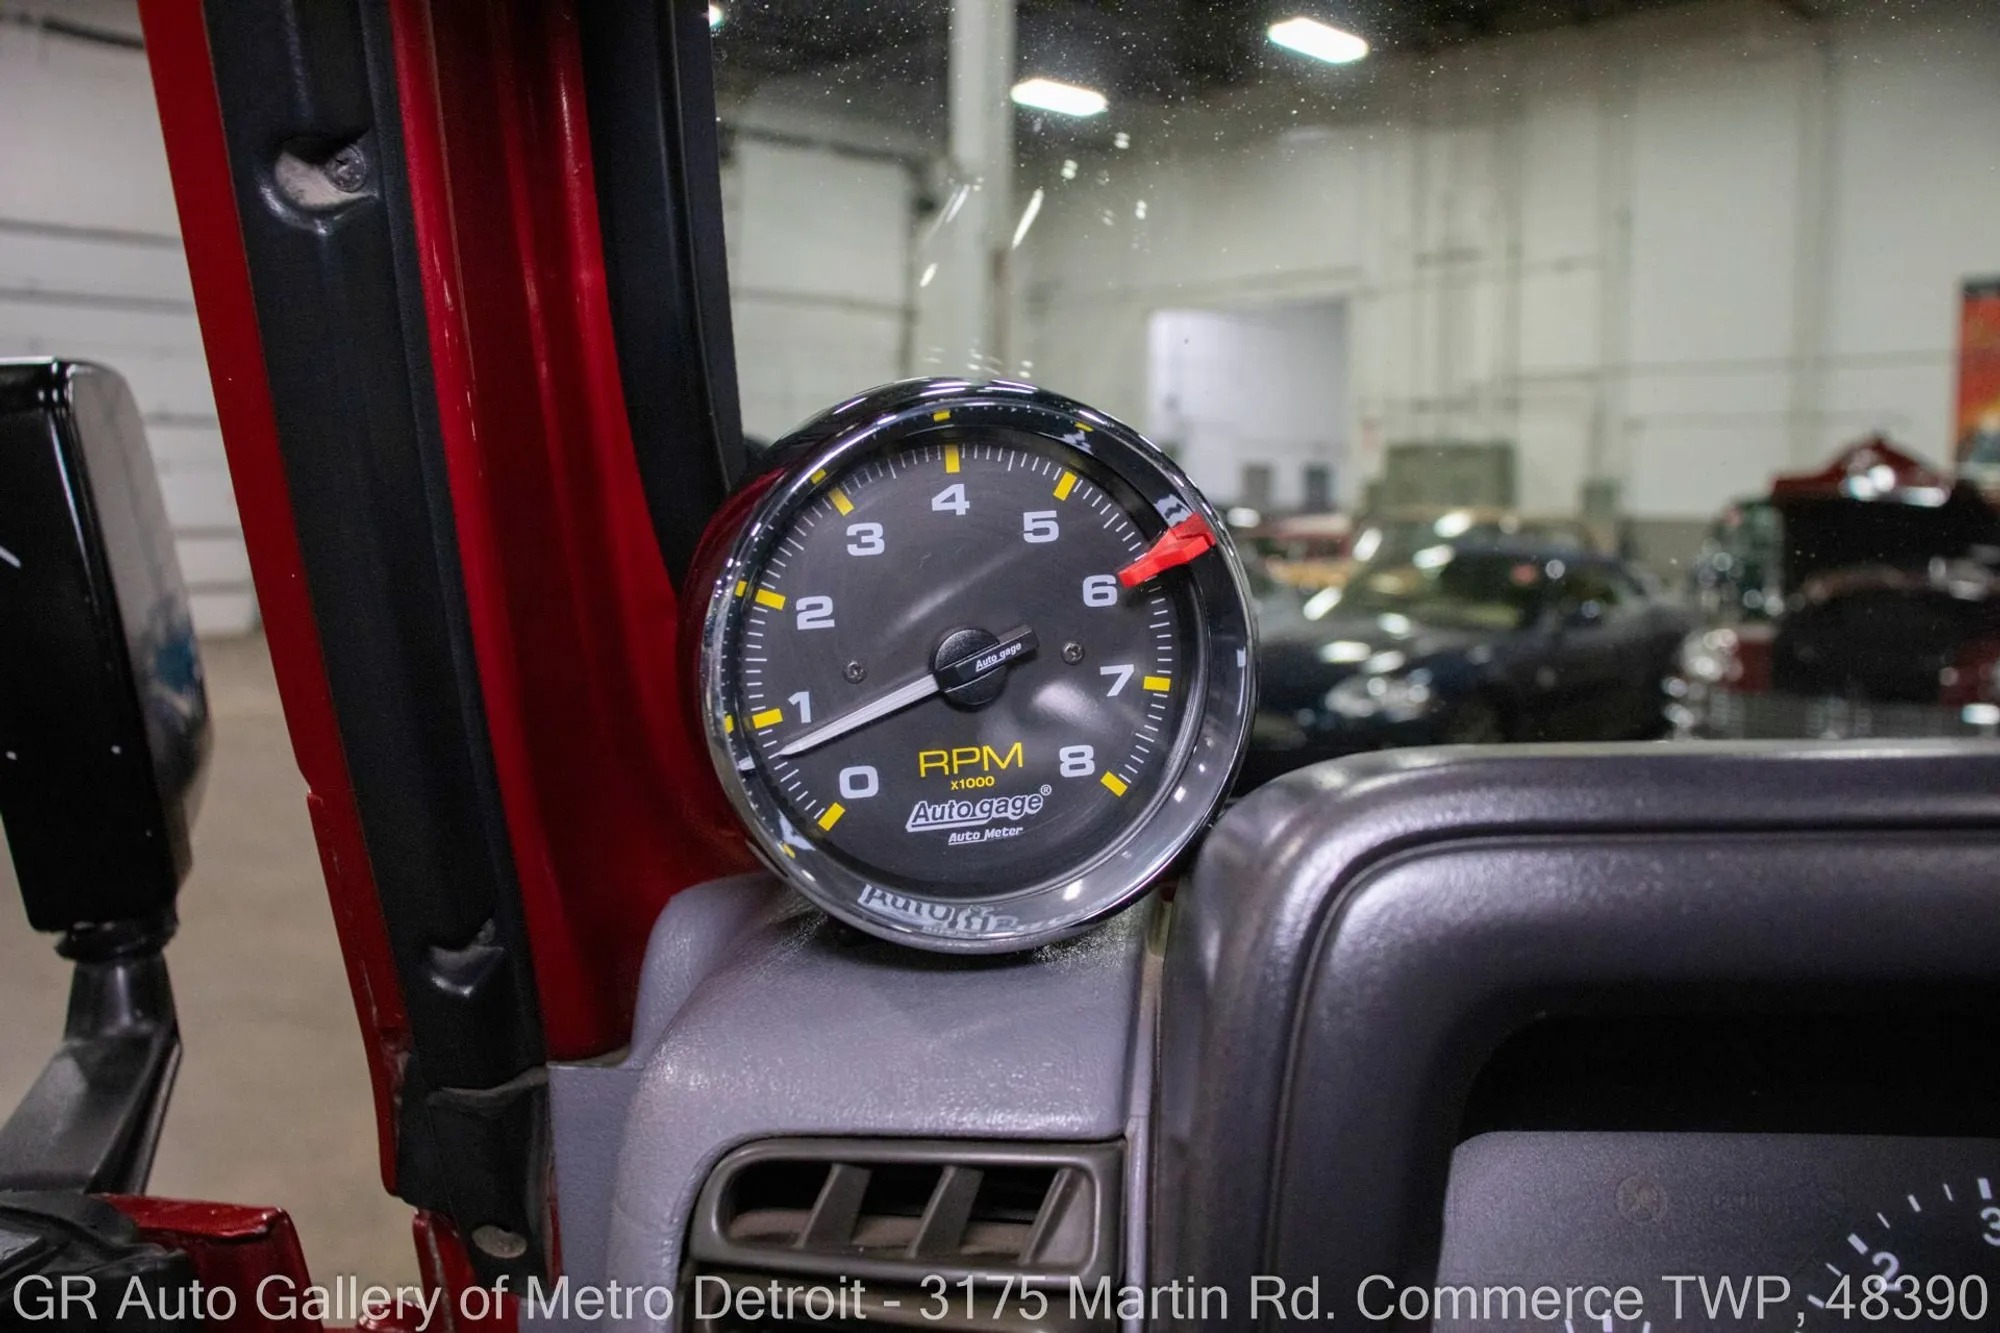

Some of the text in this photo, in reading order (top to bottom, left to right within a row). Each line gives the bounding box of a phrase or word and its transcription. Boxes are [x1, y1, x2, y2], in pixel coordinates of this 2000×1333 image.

[931, 480, 971, 516] 4
[845, 521, 886, 557] 3
[1023, 510, 1060, 544] 5
[1082, 573, 1118, 608] 6
[795, 594, 836, 631] 2
[1100, 663, 1137, 697] 7
[787, 690, 812, 724] 1
[919, 742, 1024, 778] RPM
[1058, 744, 1096, 779] 8
[838, 764, 880, 800] 0
[948, 827, 1024, 845] Auto Meter
[1872, 1252, 1903, 1292] 2
